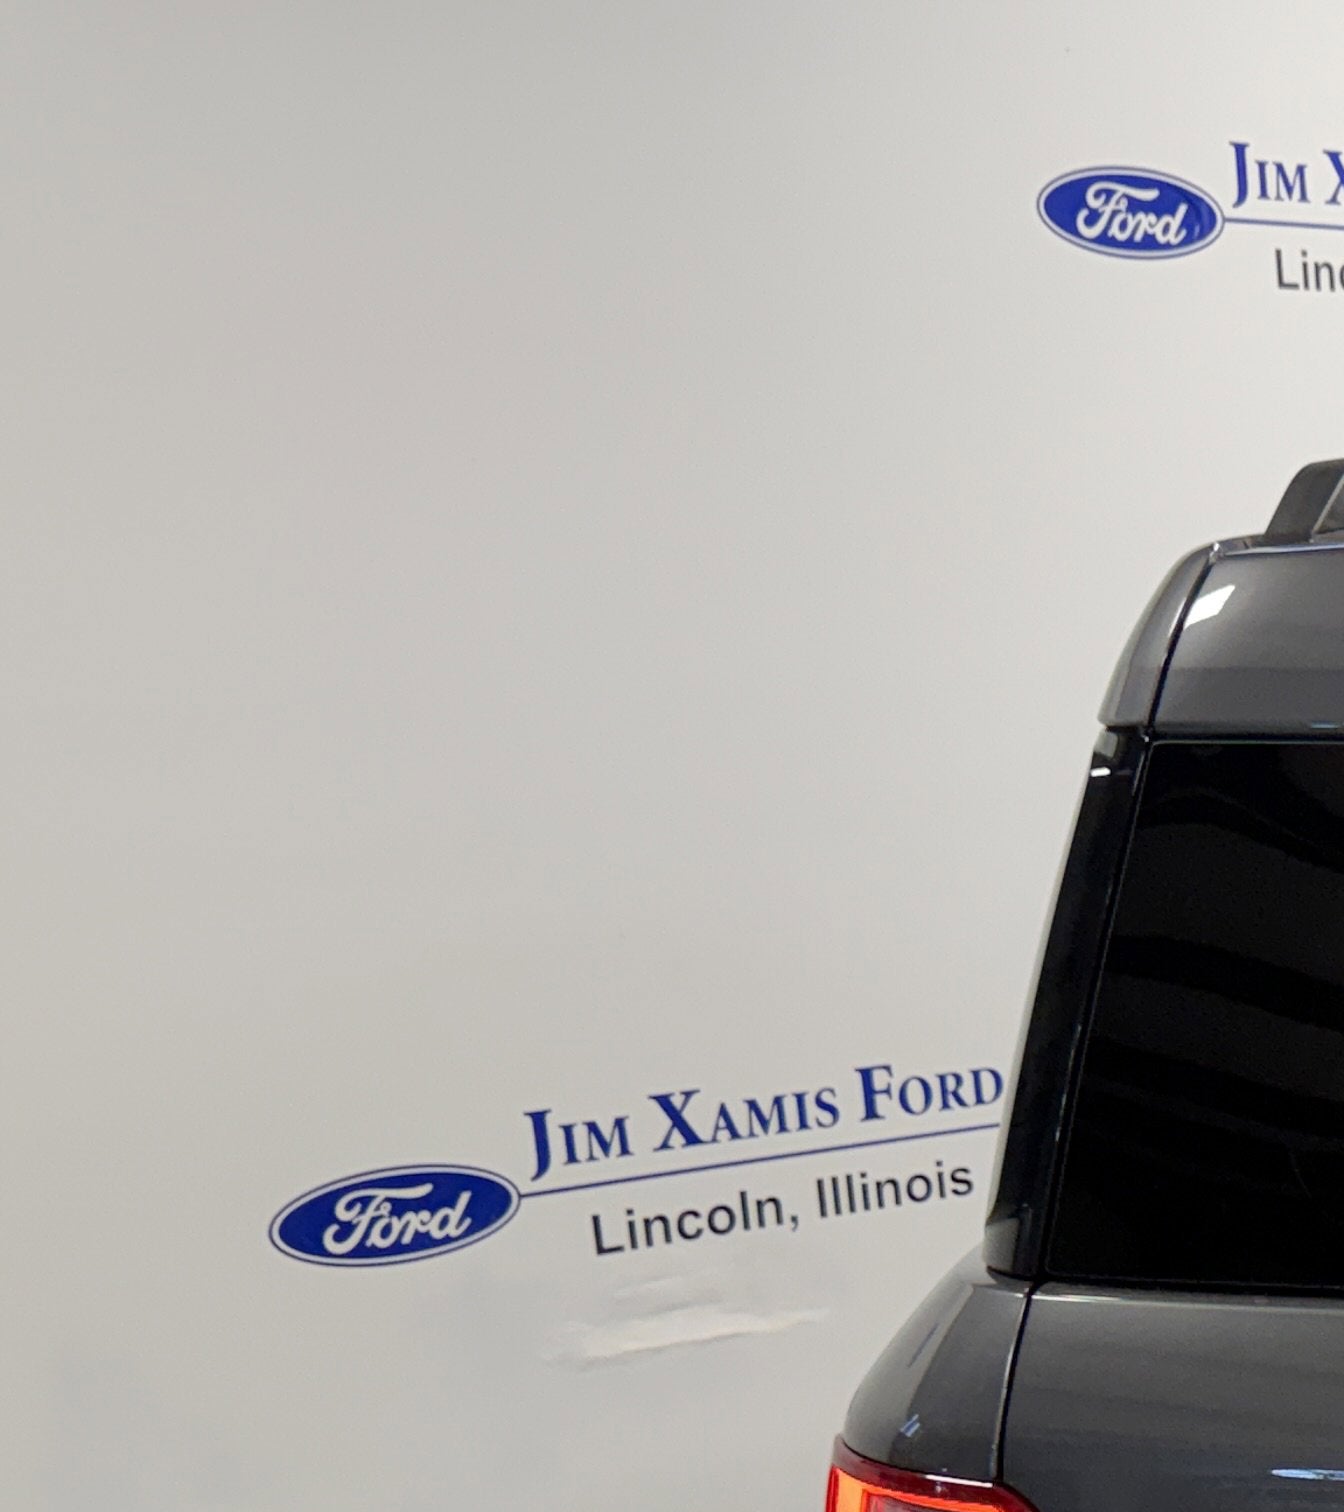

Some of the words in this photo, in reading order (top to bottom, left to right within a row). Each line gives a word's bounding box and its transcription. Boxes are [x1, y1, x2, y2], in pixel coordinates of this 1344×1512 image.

[1229, 141, 1312, 208] JIM
[1075, 180, 1188, 247] Ford
[523, 1109, 632, 1182] JIM
[647, 1087, 841, 1153] XAMIS
[854, 1064, 1004, 1122] FORD
[322, 1182, 471, 1255] Ford
[592, 1189, 800, 1255] Lincoln,
[816, 1160, 974, 1218] Illinois
